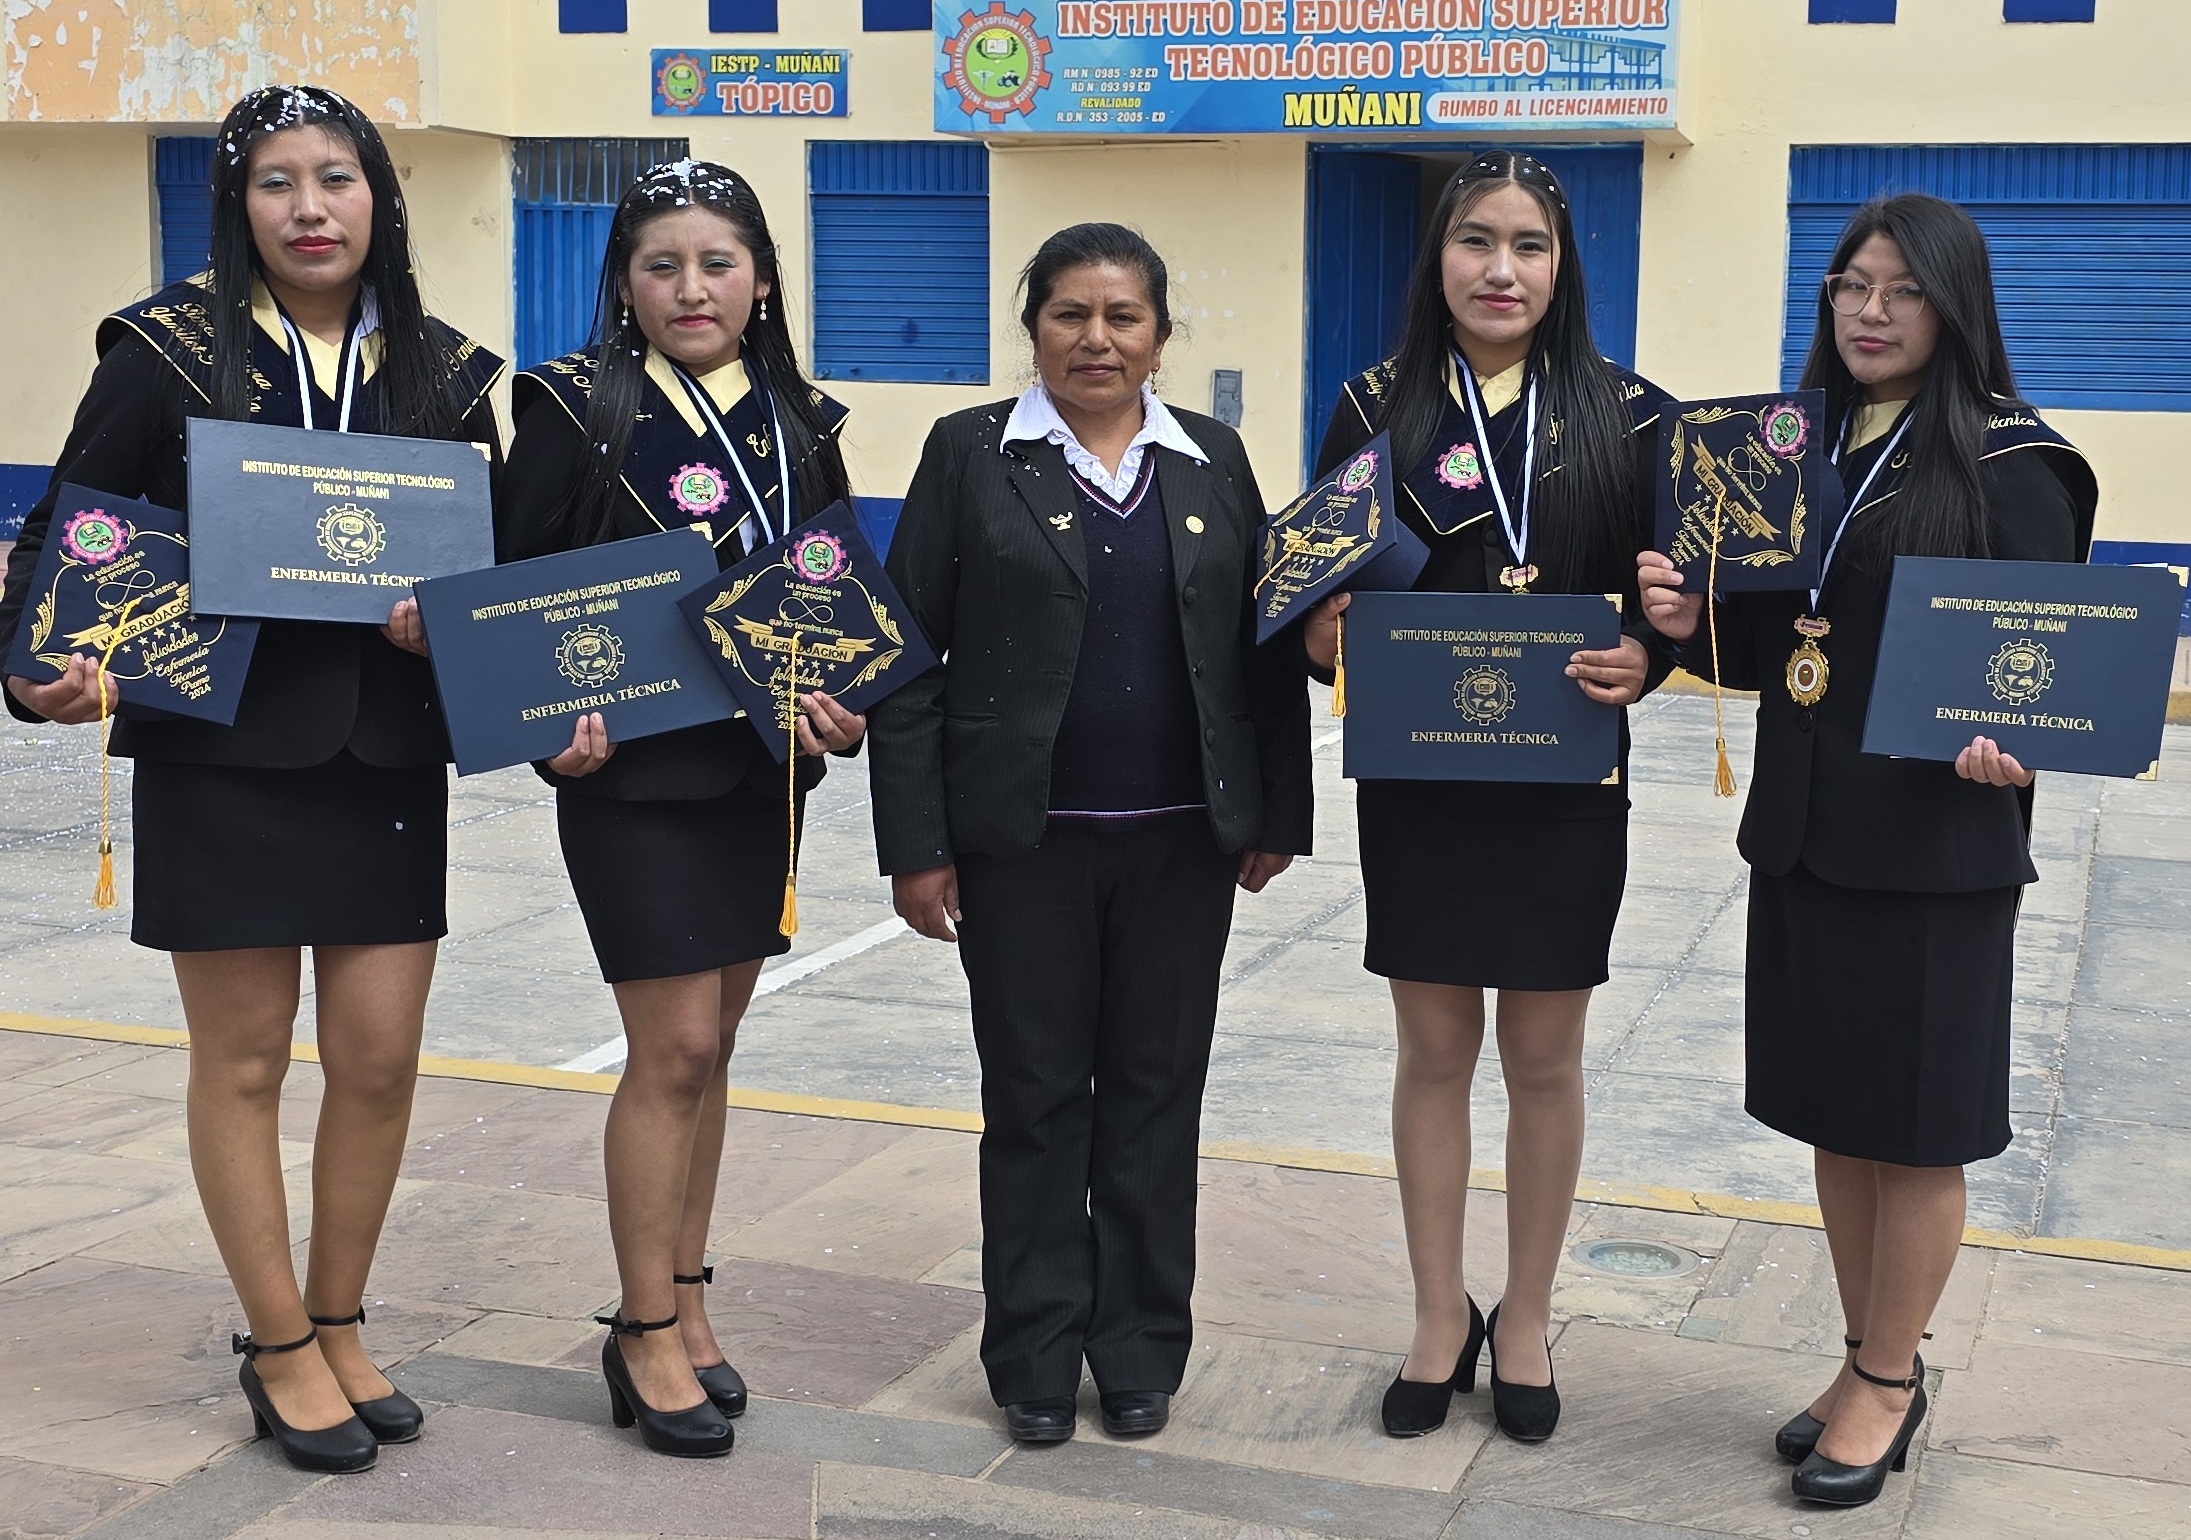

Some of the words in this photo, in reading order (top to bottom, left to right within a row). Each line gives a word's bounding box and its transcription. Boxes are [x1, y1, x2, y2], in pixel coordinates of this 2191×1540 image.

[1058, 2, 1233, 37] INSTITUTO
[1241, 1, 1285, 34] DE
[1492, 0, 1668, 30] SUPERIOR
[711, 55, 760, 73] IESTP
[775, 52, 841, 73] MUÑANI
[1165, 36, 1393, 80] TECNOLÓGICO
[1402, 33, 1549, 77] PÚBLICO
[1094, 68, 1120, 78] 0985
[1129, 68, 1143, 78] 92
[1144, 68, 1159, 78] ED
[717, 76, 834, 114] TÓPICO
[1101, 82, 1120, 92] 093
[1122, 82, 1135, 92] 99
[1137, 82, 1151, 92] ED
[1080, 97, 1142, 108] REVALIDADO
[1283, 84, 1421, 127] MUÑANI
[1438, 99, 1498, 118] RUMBO
[1504, 99, 1523, 117] AL
[1529, 97, 1669, 117] LICENCIAMIENTO
[1088, 112, 1108, 122] 353
[1116, 112, 1144, 122] 2005
[1151, 112, 1166, 122] ED
[242, 460, 287, 476] INSTITUTO
[289, 464, 300, 477] DE
[302, 465, 352, 482] EDUCACIÓN
[353, 470, 395, 485] SUPERIOR
[396, 473, 455, 490] TECNOLÓGICO
[1696, 464, 1708, 478] MI
[313, 481, 350, 497] PÚBLICO
[356, 484, 389, 499] MUÑANI
[270, 566, 368, 585] ENFERMERIA
[370, 571, 431, 588] TÉCNI
[471, 602, 517, 621] INSTITUTO
[517, 599, 529, 612] DE
[529, 588, 579, 610] EDUCACIÓN
[580, 581, 622, 601] SUPERIOR
[622, 570, 681, 592] TECNOLÓGICO
[543, 604, 581, 624] PÚBLICO
[586, 598, 619, 616] MUÑANI
[1930, 597, 1972, 611] INSTITUTO
[1973, 599, 1985, 612] DE
[1985, 599, 2034, 614] EDUCACIÓN
[2034, 602, 2076, 616] SUPERIOR
[2077, 604, 2138, 620] TECNOLÓGICO
[1992, 615, 2028, 631] PÚBLICO
[2033, 617, 2067, 632] MUÑANI
[755, 637, 769, 648] MI
[1390, 629, 1430, 641] INSTITUTO
[1431, 630, 1442, 641] DE
[1443, 628, 1488, 642] EDUCACIÓN
[1489, 630, 1528, 643] SUPERIOR
[1529, 630, 1584, 644] TECNOLÓGICO
[1452, 645, 1486, 658] PÚBLICO
[1491, 646, 1522, 658] MUÑANI
[521, 692, 616, 721] ENFERMERIA
[617, 678, 682, 701] TÉCNICA
[1935, 707, 2027, 726] ENFERMERIA
[2030, 713, 2094, 732] TÉCNICA
[1411, 731, 1497, 743] ENFERMERIA
[1500, 730, 1559, 745] TÉCNICA
